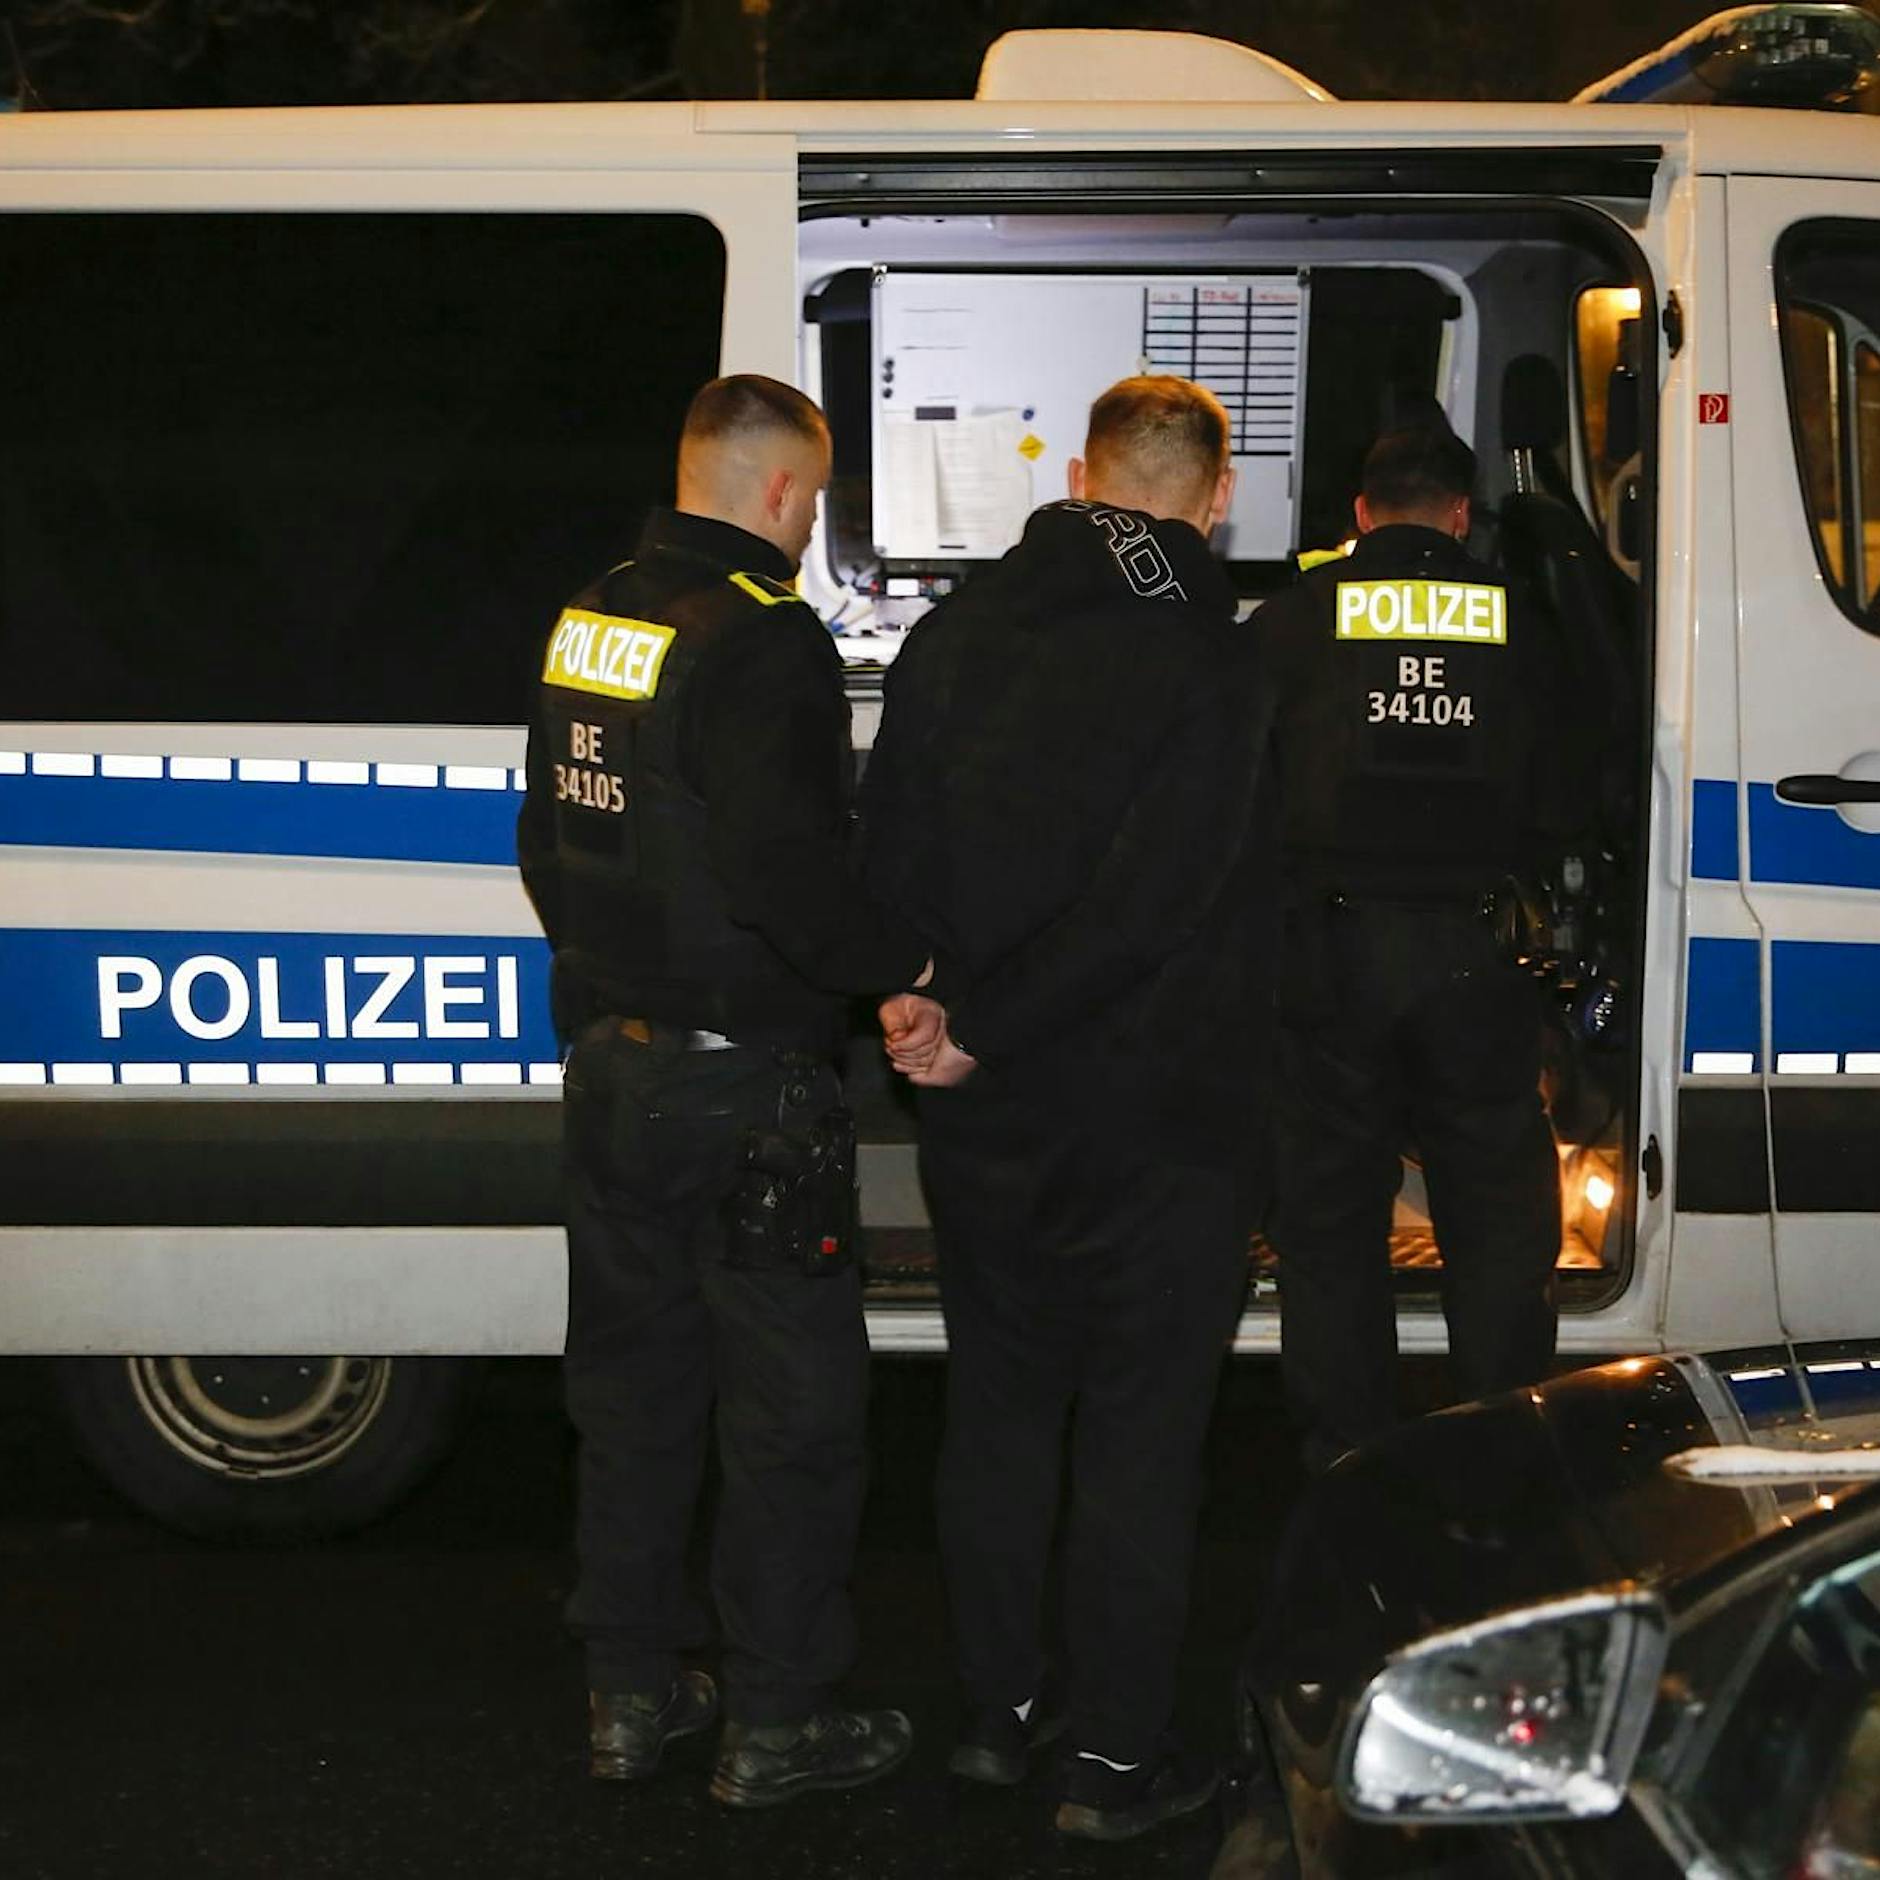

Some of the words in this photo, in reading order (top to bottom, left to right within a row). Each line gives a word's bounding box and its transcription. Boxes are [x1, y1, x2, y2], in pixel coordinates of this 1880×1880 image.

[1061, 502, 1189, 601] RD
[1341, 585, 1502, 639] POLIZEI
[550, 620, 665, 692] POLIZEI
[1399, 656, 1445, 688] BE
[1368, 692, 1474, 727] 34104
[570, 721, 604, 765] BE
[553, 764, 626, 813] 34105
[97, 955, 519, 1040] POLIZEI
